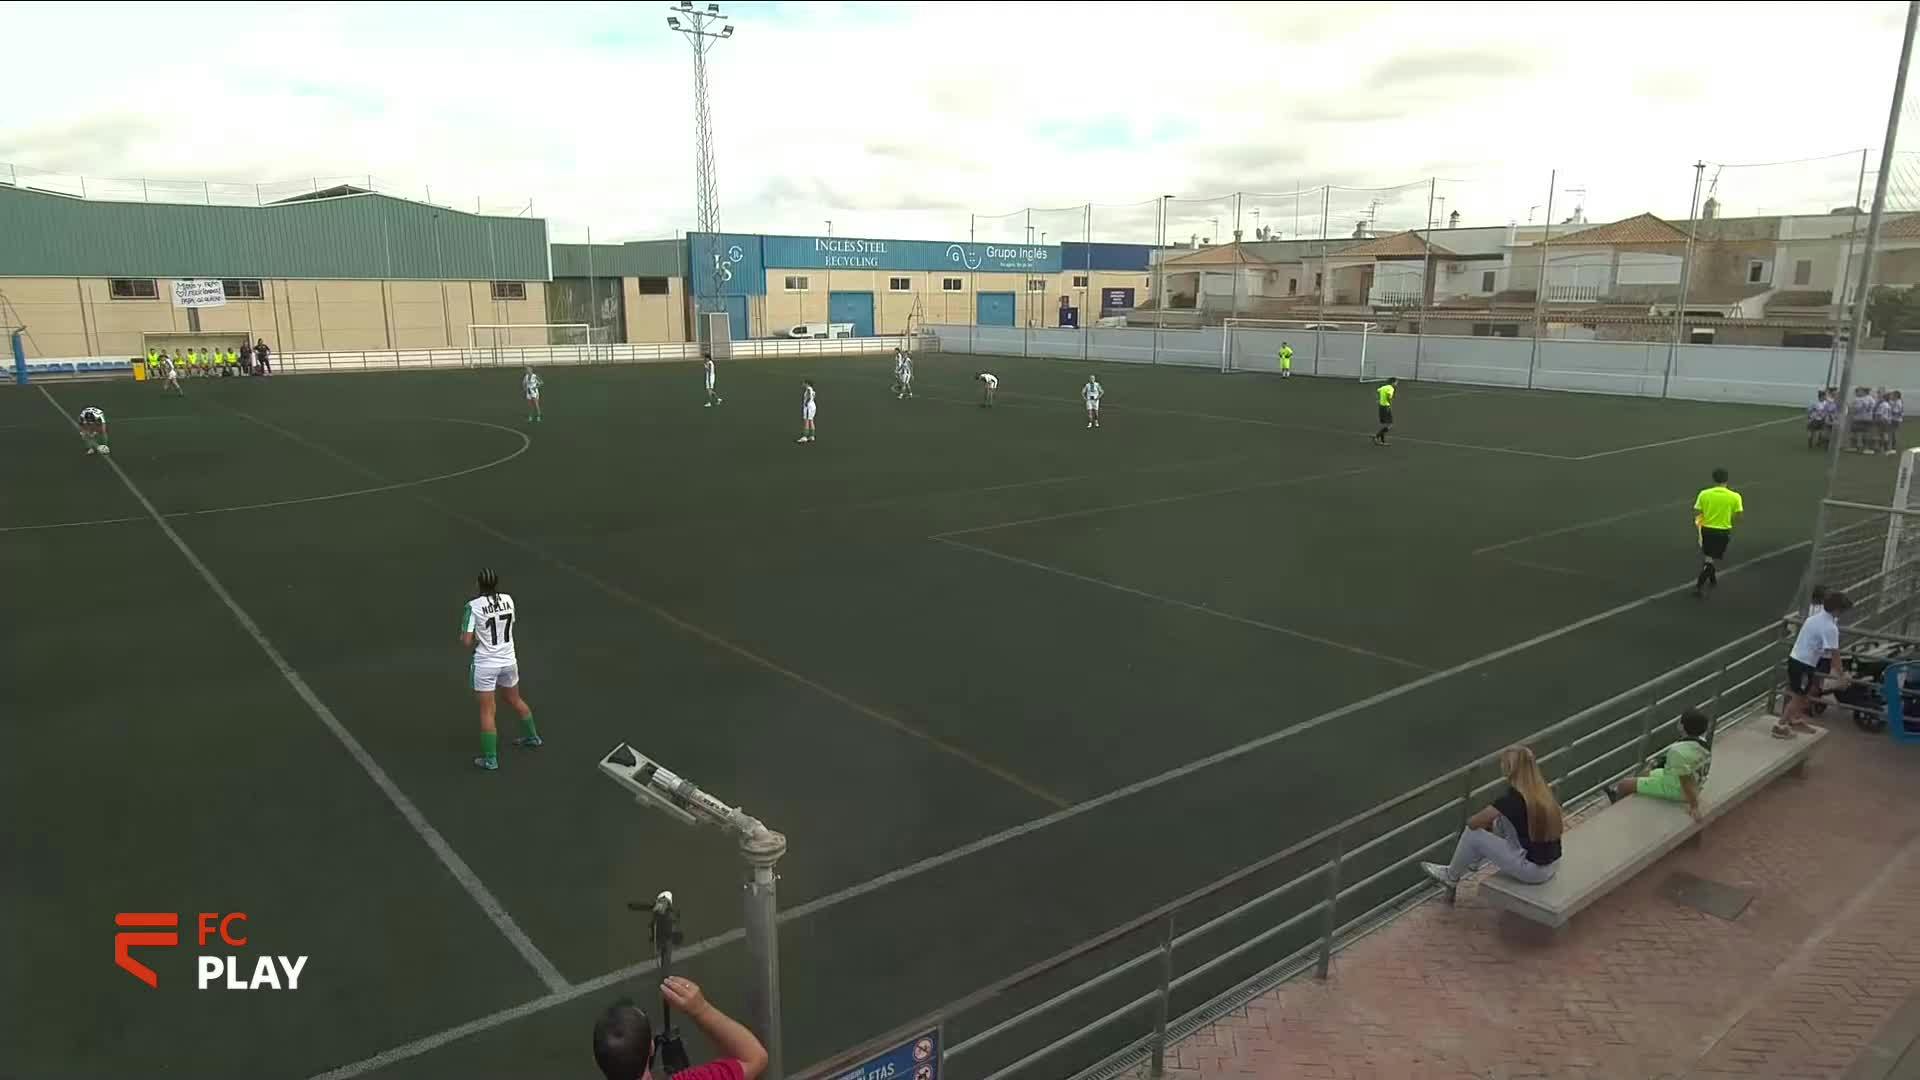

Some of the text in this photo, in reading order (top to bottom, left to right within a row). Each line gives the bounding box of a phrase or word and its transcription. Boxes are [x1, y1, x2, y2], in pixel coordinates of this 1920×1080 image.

[857, 240, 887, 253] STEEL
[952, 252, 960, 261] G
[986, 246, 1048, 261] Grupo Inglés
[826, 256, 878, 267] RECYCLING
[485, 613, 512, 646] 17
